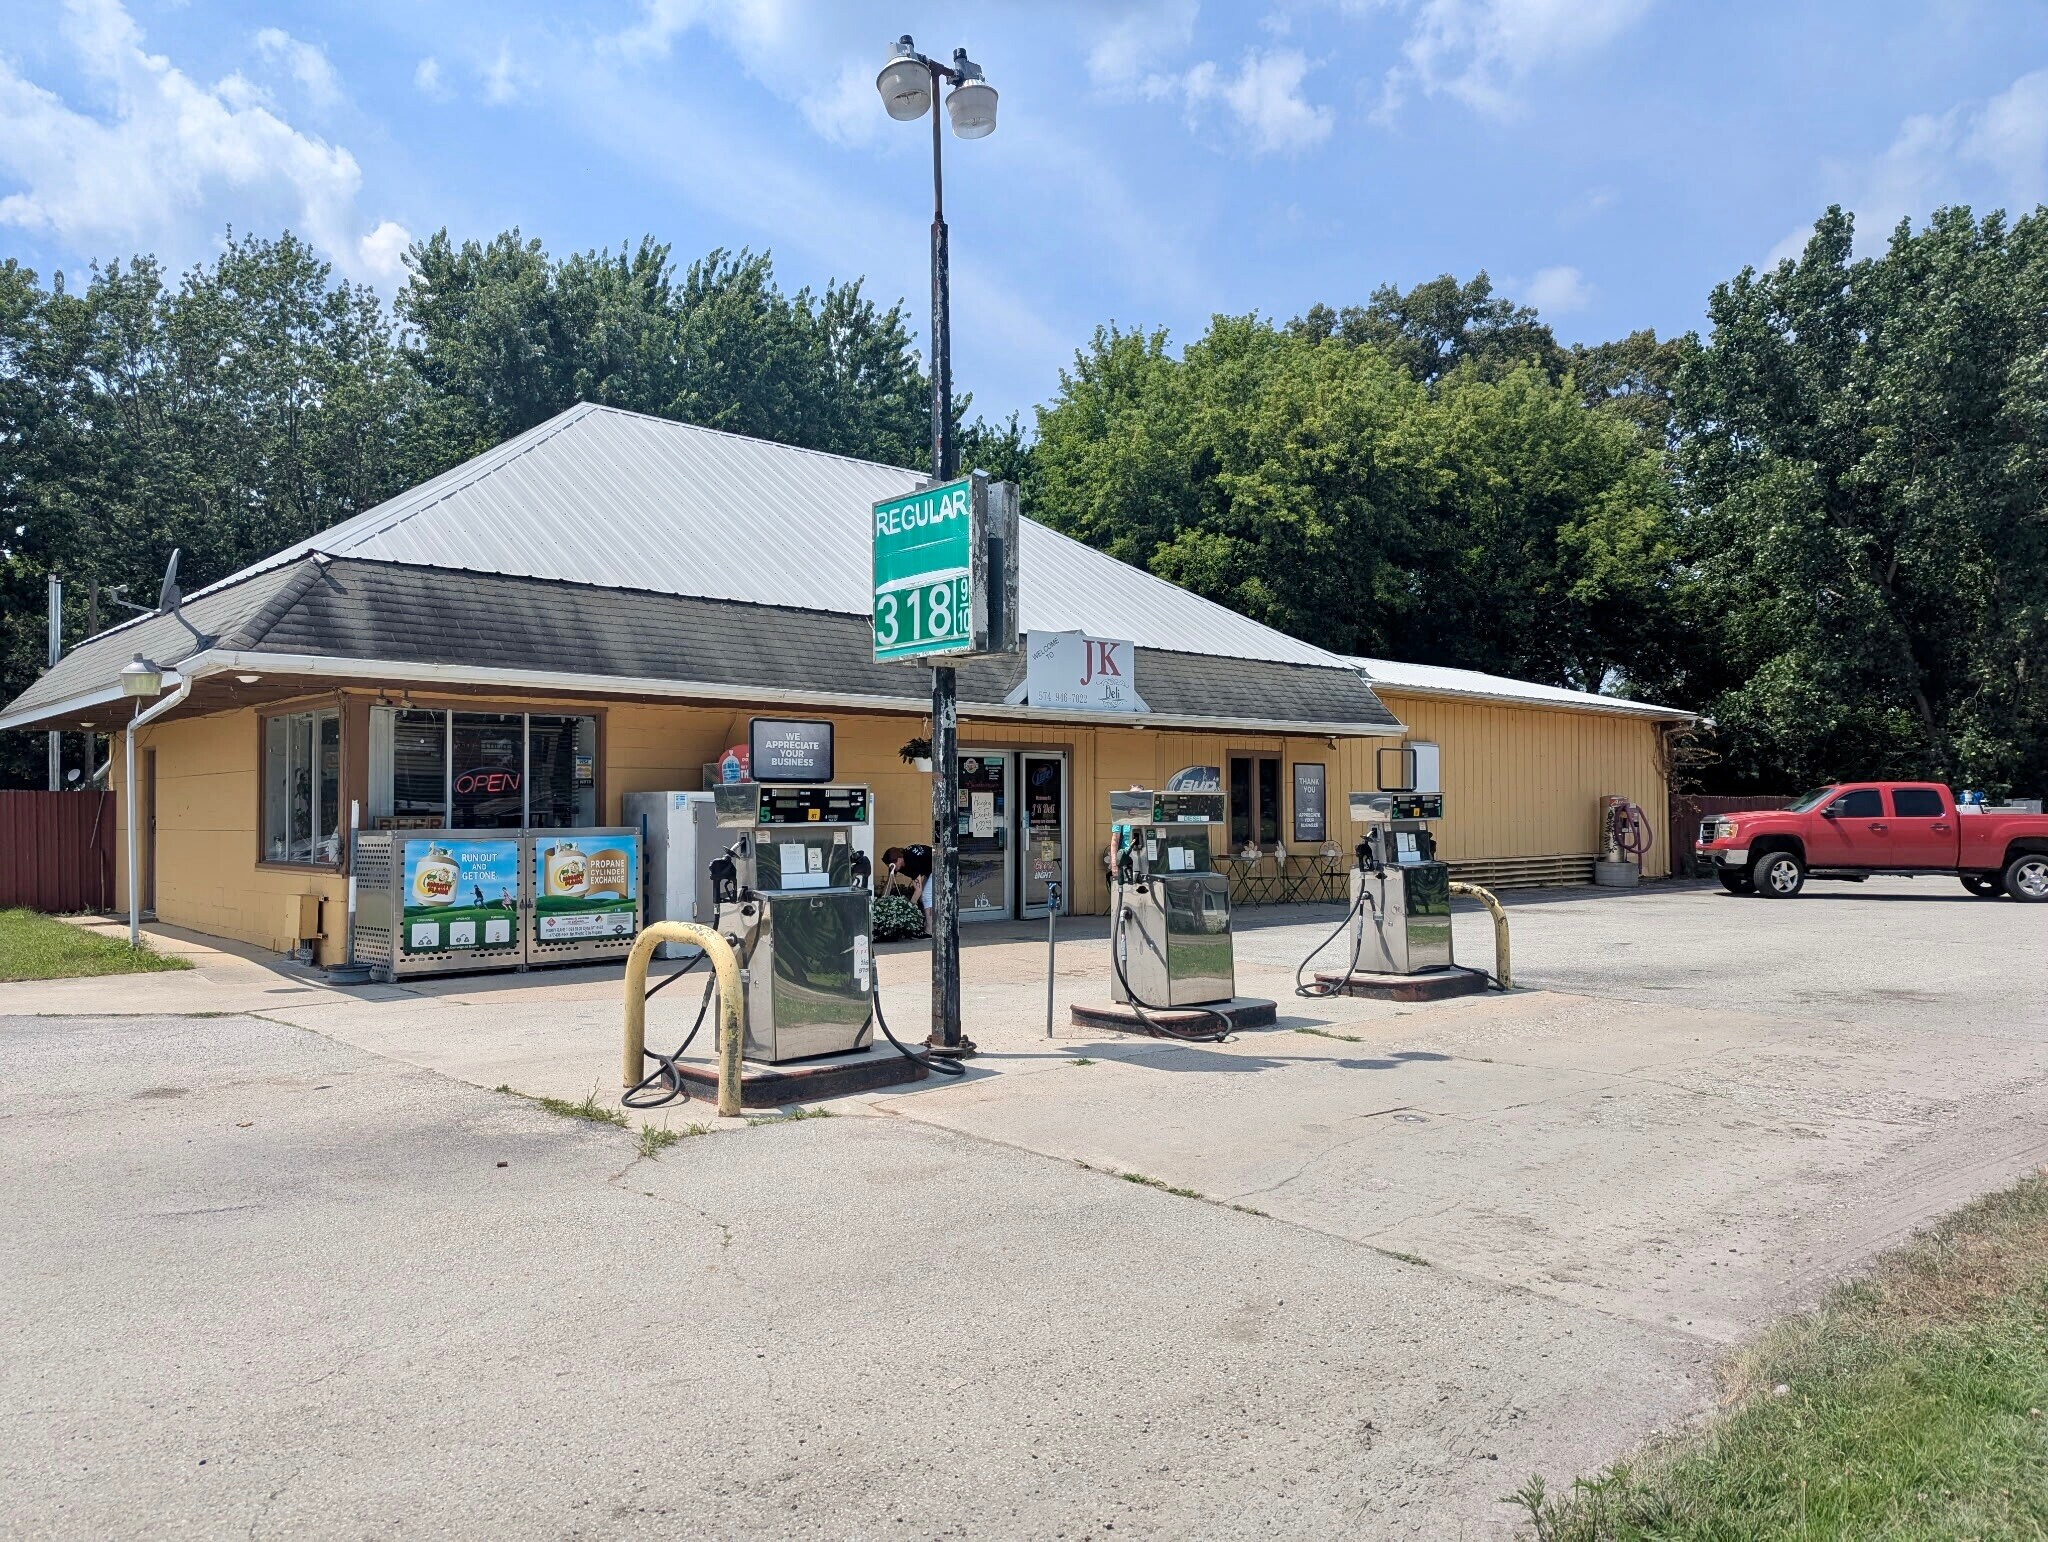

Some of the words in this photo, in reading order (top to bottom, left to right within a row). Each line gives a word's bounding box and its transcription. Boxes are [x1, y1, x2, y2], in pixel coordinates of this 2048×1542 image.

[876, 490, 969, 537] REGULAR
[960, 577, 968, 601] 9
[877, 584, 952, 645] 318
[957, 607, 969, 632] 10
[1032, 636, 1060, 660] WELCOME
[1045, 651, 1055, 660] TO
[1080, 639, 1121, 686] JK
[1105, 684, 1120, 699] Deli
[1038, 691, 1052, 702] 574
[1055, 692, 1088, 704] 946-7022
[765, 740, 820, 750] APPRECIATE
[780, 750, 805, 758] YOUR
[771, 758, 814, 767] BUSINESS
[456, 773, 521, 794] OPEN
[1299, 777, 1320, 786] THANK
[1303, 785, 1316, 793] YOU
[760, 806, 771, 822] 5
[854, 806, 865, 820] 4
[1154, 808, 1161, 820] 3
[1392, 807, 1399, 818] 2
[461, 853, 479, 862] RUN
[480, 853, 498, 862] OUT
[590, 859, 625, 868] PROPANE
[462, 871, 478, 880] GET
[590, 868, 625, 876] CYLINDER
[590, 875, 625, 885] EXCHANGE
